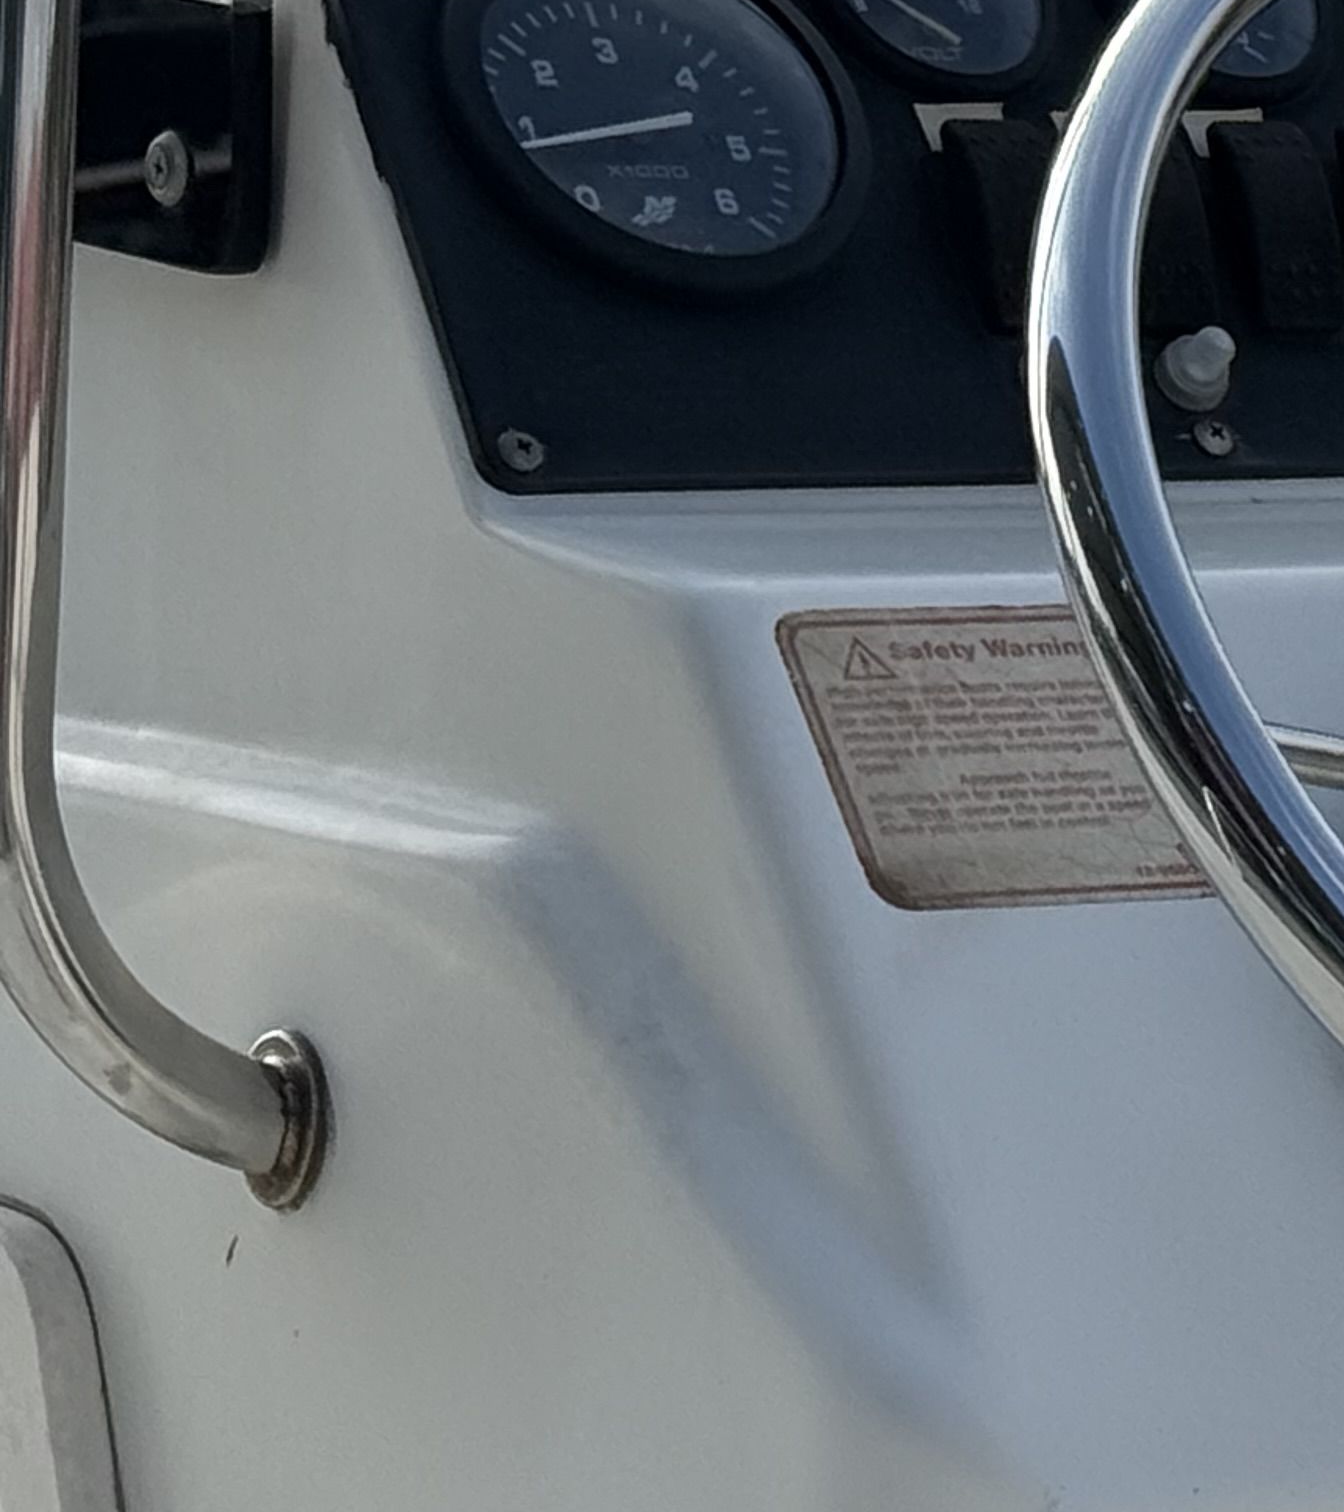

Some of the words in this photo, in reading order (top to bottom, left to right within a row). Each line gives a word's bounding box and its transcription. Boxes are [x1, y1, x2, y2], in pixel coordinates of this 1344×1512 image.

[592, 37, 619, 65] 3
[530, 59, 559, 88] 2
[674, 65, 699, 94] 4
[518, 114, 537, 142] 1
[725, 134, 752, 163] 5
[606, 164, 690, 181] X1000
[573, 184, 604, 213] 0
[713, 187, 740, 217] 6
[888, 639, 976, 663] Safety
